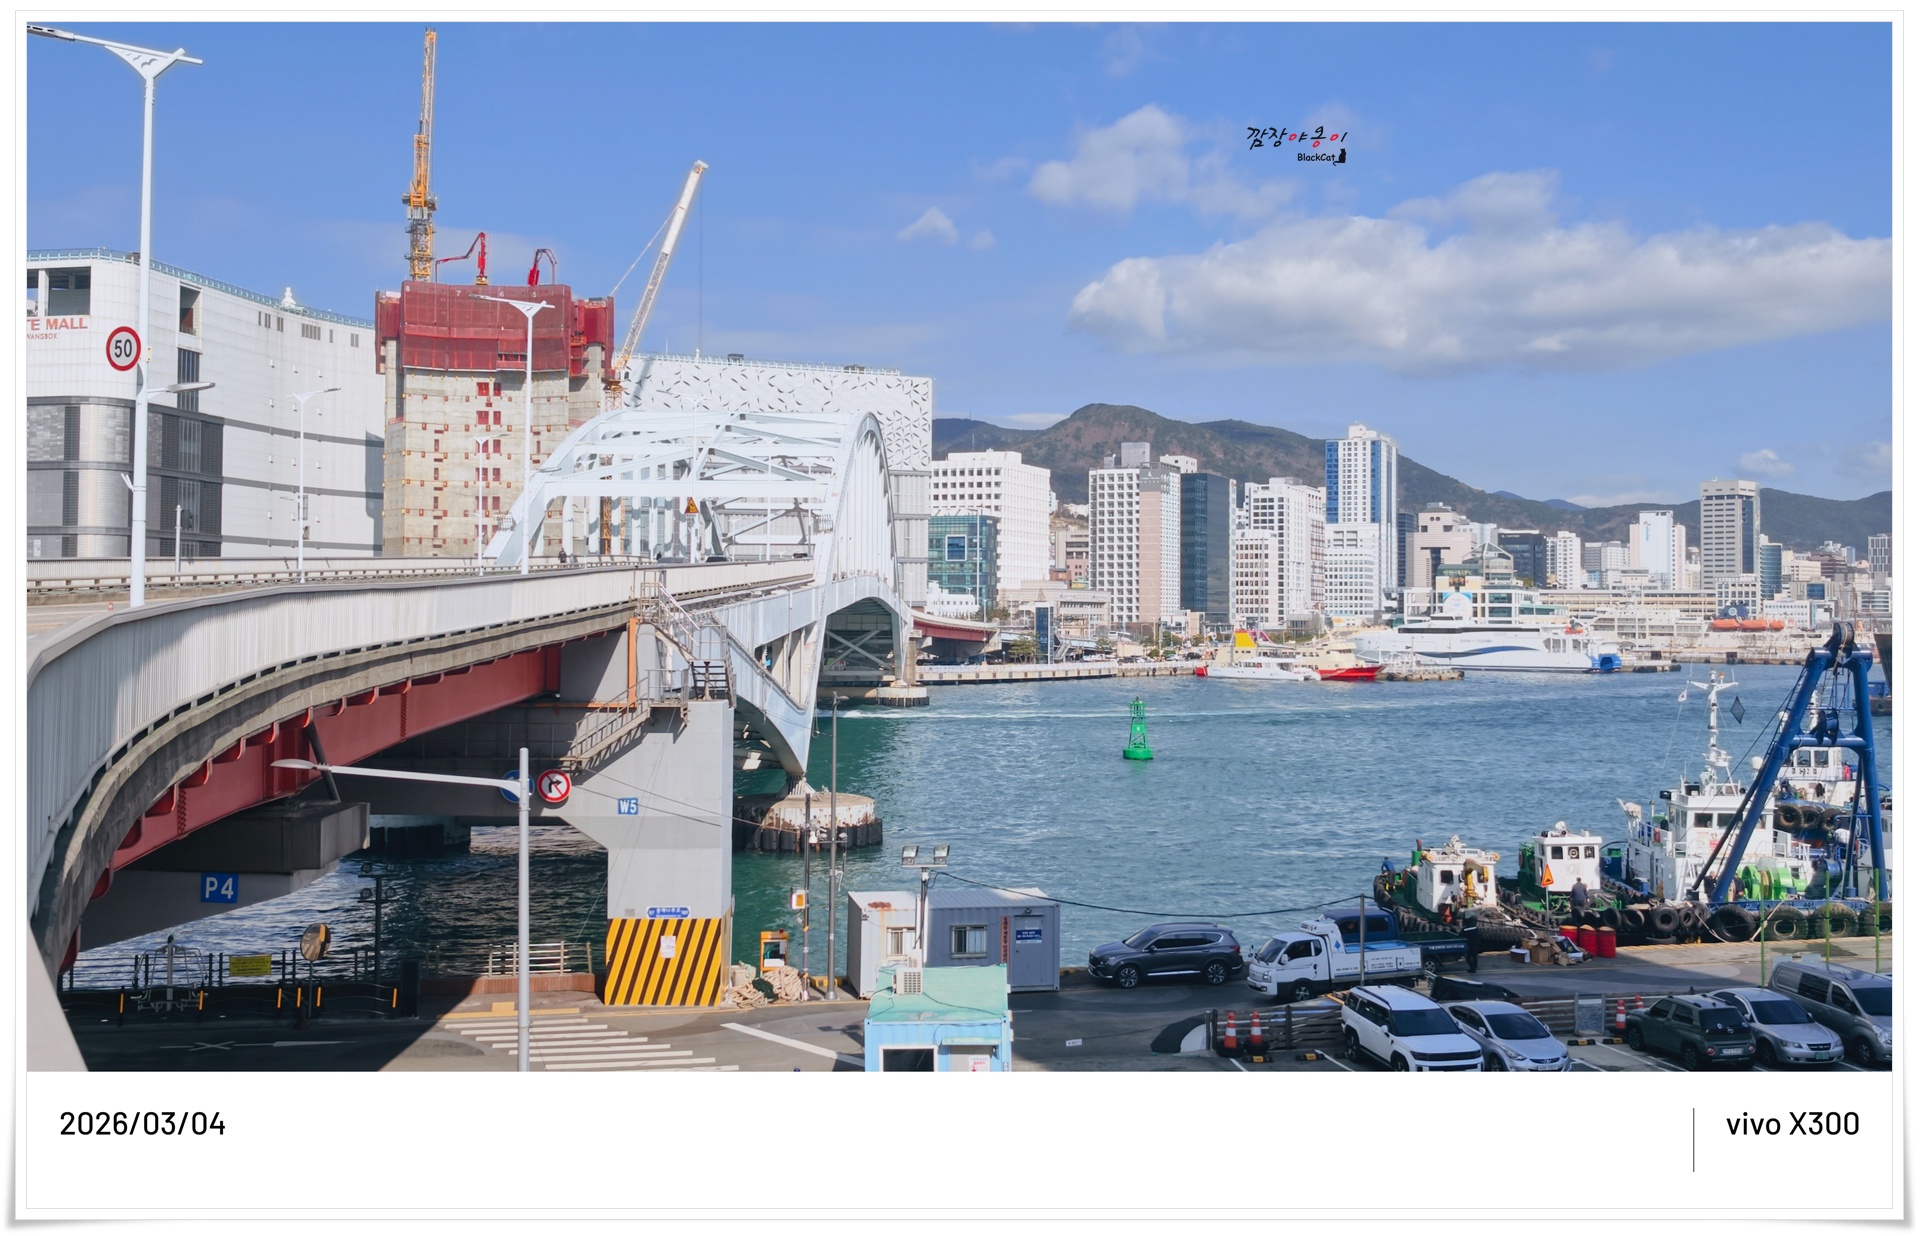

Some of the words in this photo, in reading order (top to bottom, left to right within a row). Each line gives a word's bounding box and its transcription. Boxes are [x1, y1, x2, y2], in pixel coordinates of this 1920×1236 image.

[27, 319, 40, 331] E
[46, 317, 88, 330] MALL
[114, 338, 133, 358] 50
[619, 799, 637, 814] W5
[205, 876, 234, 899] P4
